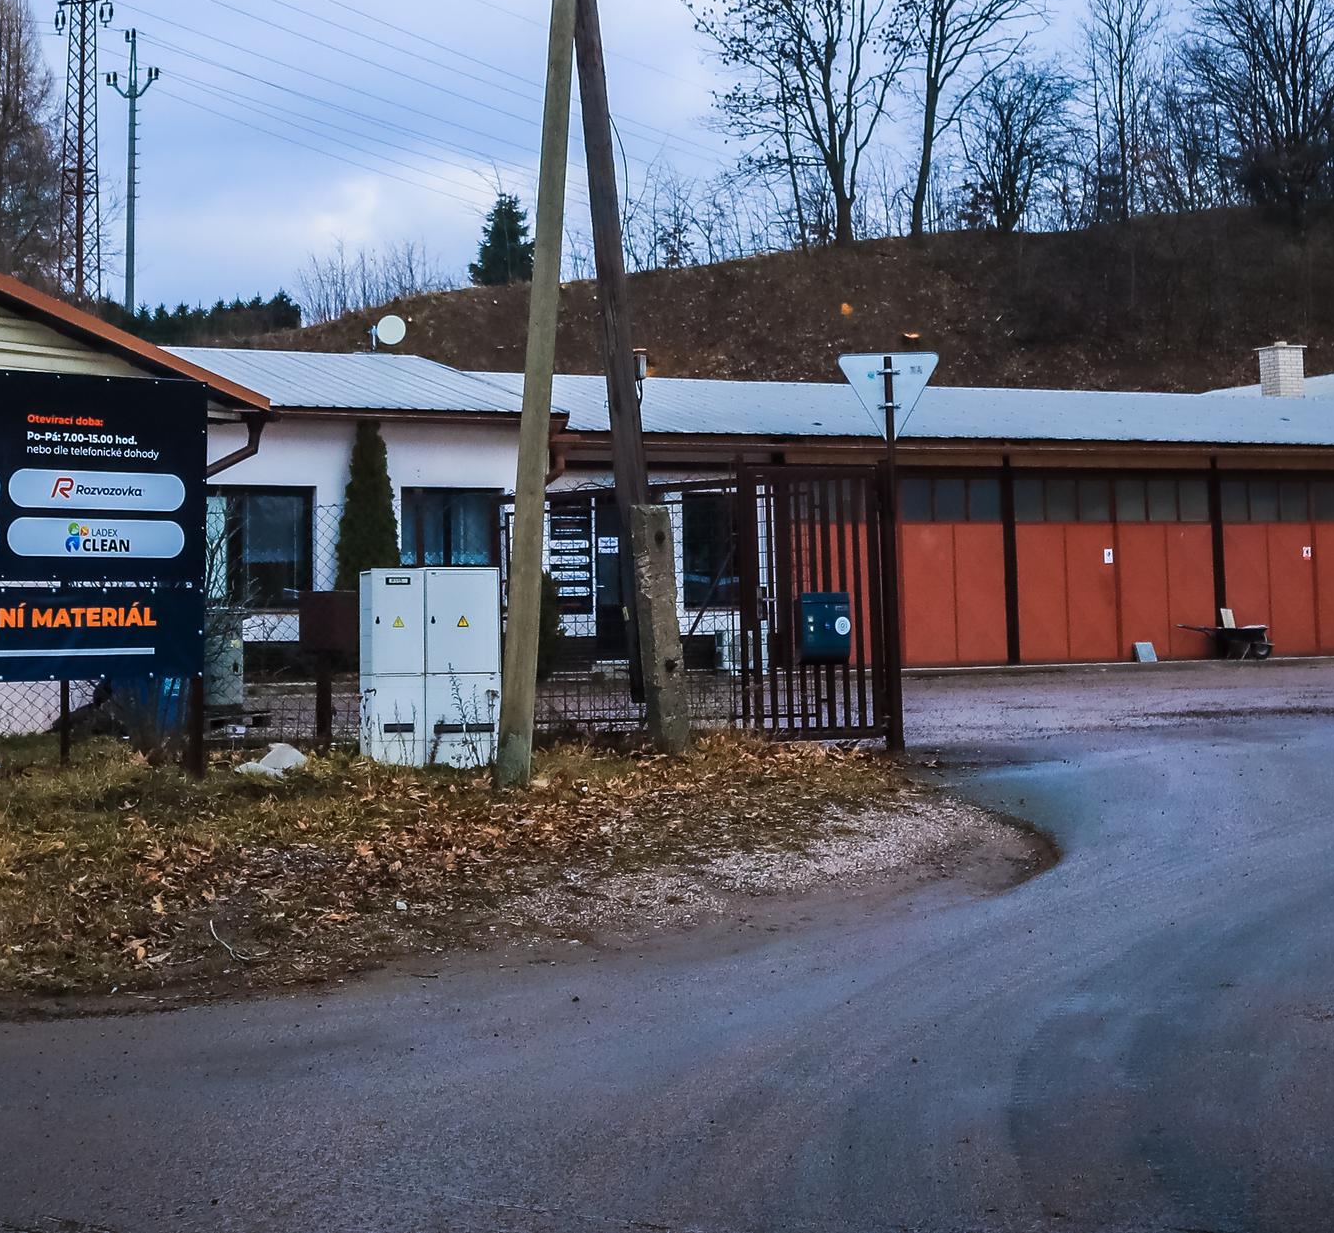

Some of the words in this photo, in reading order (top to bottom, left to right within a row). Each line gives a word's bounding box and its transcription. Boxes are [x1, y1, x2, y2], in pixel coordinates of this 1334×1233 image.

[75, 416, 104, 426] doba:
[115, 434, 138, 445] hod.
[27, 444, 52, 455] nebo
[53, 445, 69, 455] dle
[70, 446, 122, 457] telefonické
[123, 448, 159, 461] dohody
[75, 484, 143, 497] Rozvozovka
[91, 528, 118, 537] LADEX
[82, 538, 130, 553] CLEAN
[32, 601, 157, 628] MATERIÁL
